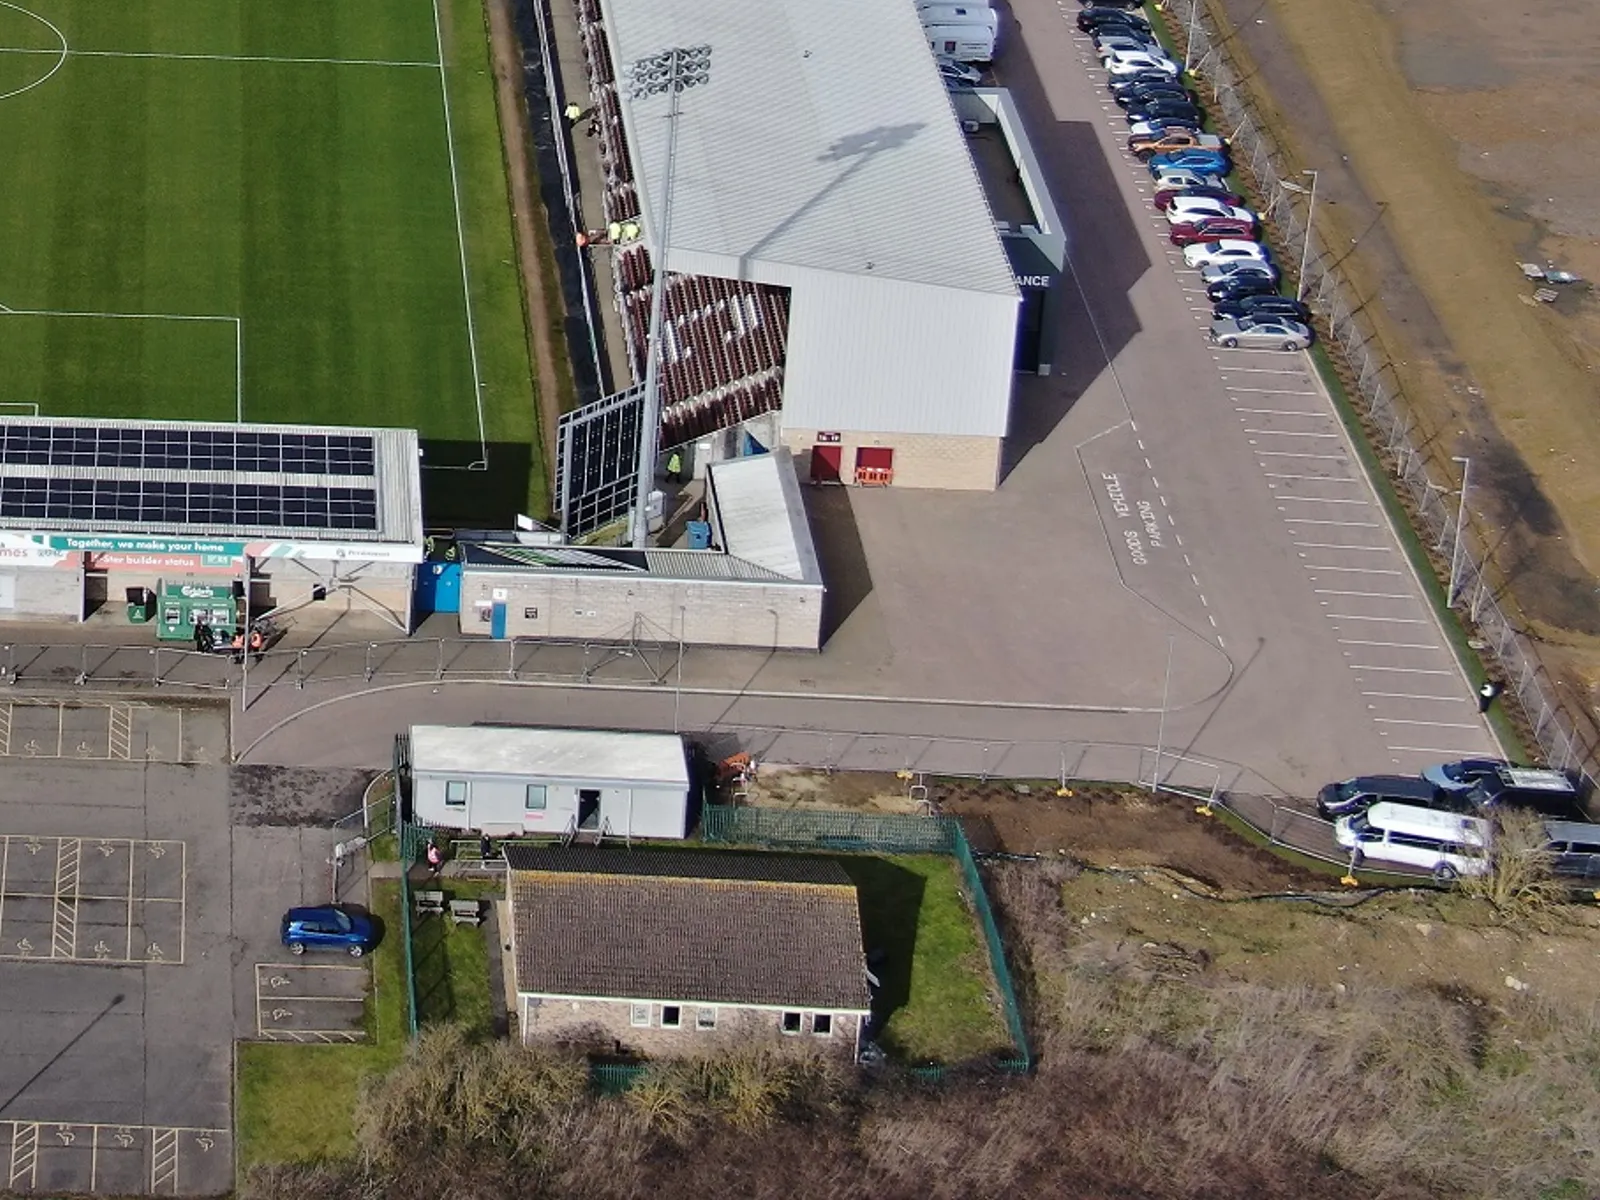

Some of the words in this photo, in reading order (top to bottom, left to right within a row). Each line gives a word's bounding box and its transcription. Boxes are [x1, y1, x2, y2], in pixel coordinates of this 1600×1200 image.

[1136, 500, 1165, 548] PARKING
[118, 541, 134, 549] we
[136, 540, 165, 550] make
[168, 543, 192, 552] your
[194, 542, 225, 553] home
[126, 555, 162, 565] builder
[164, 556, 195, 566] status
